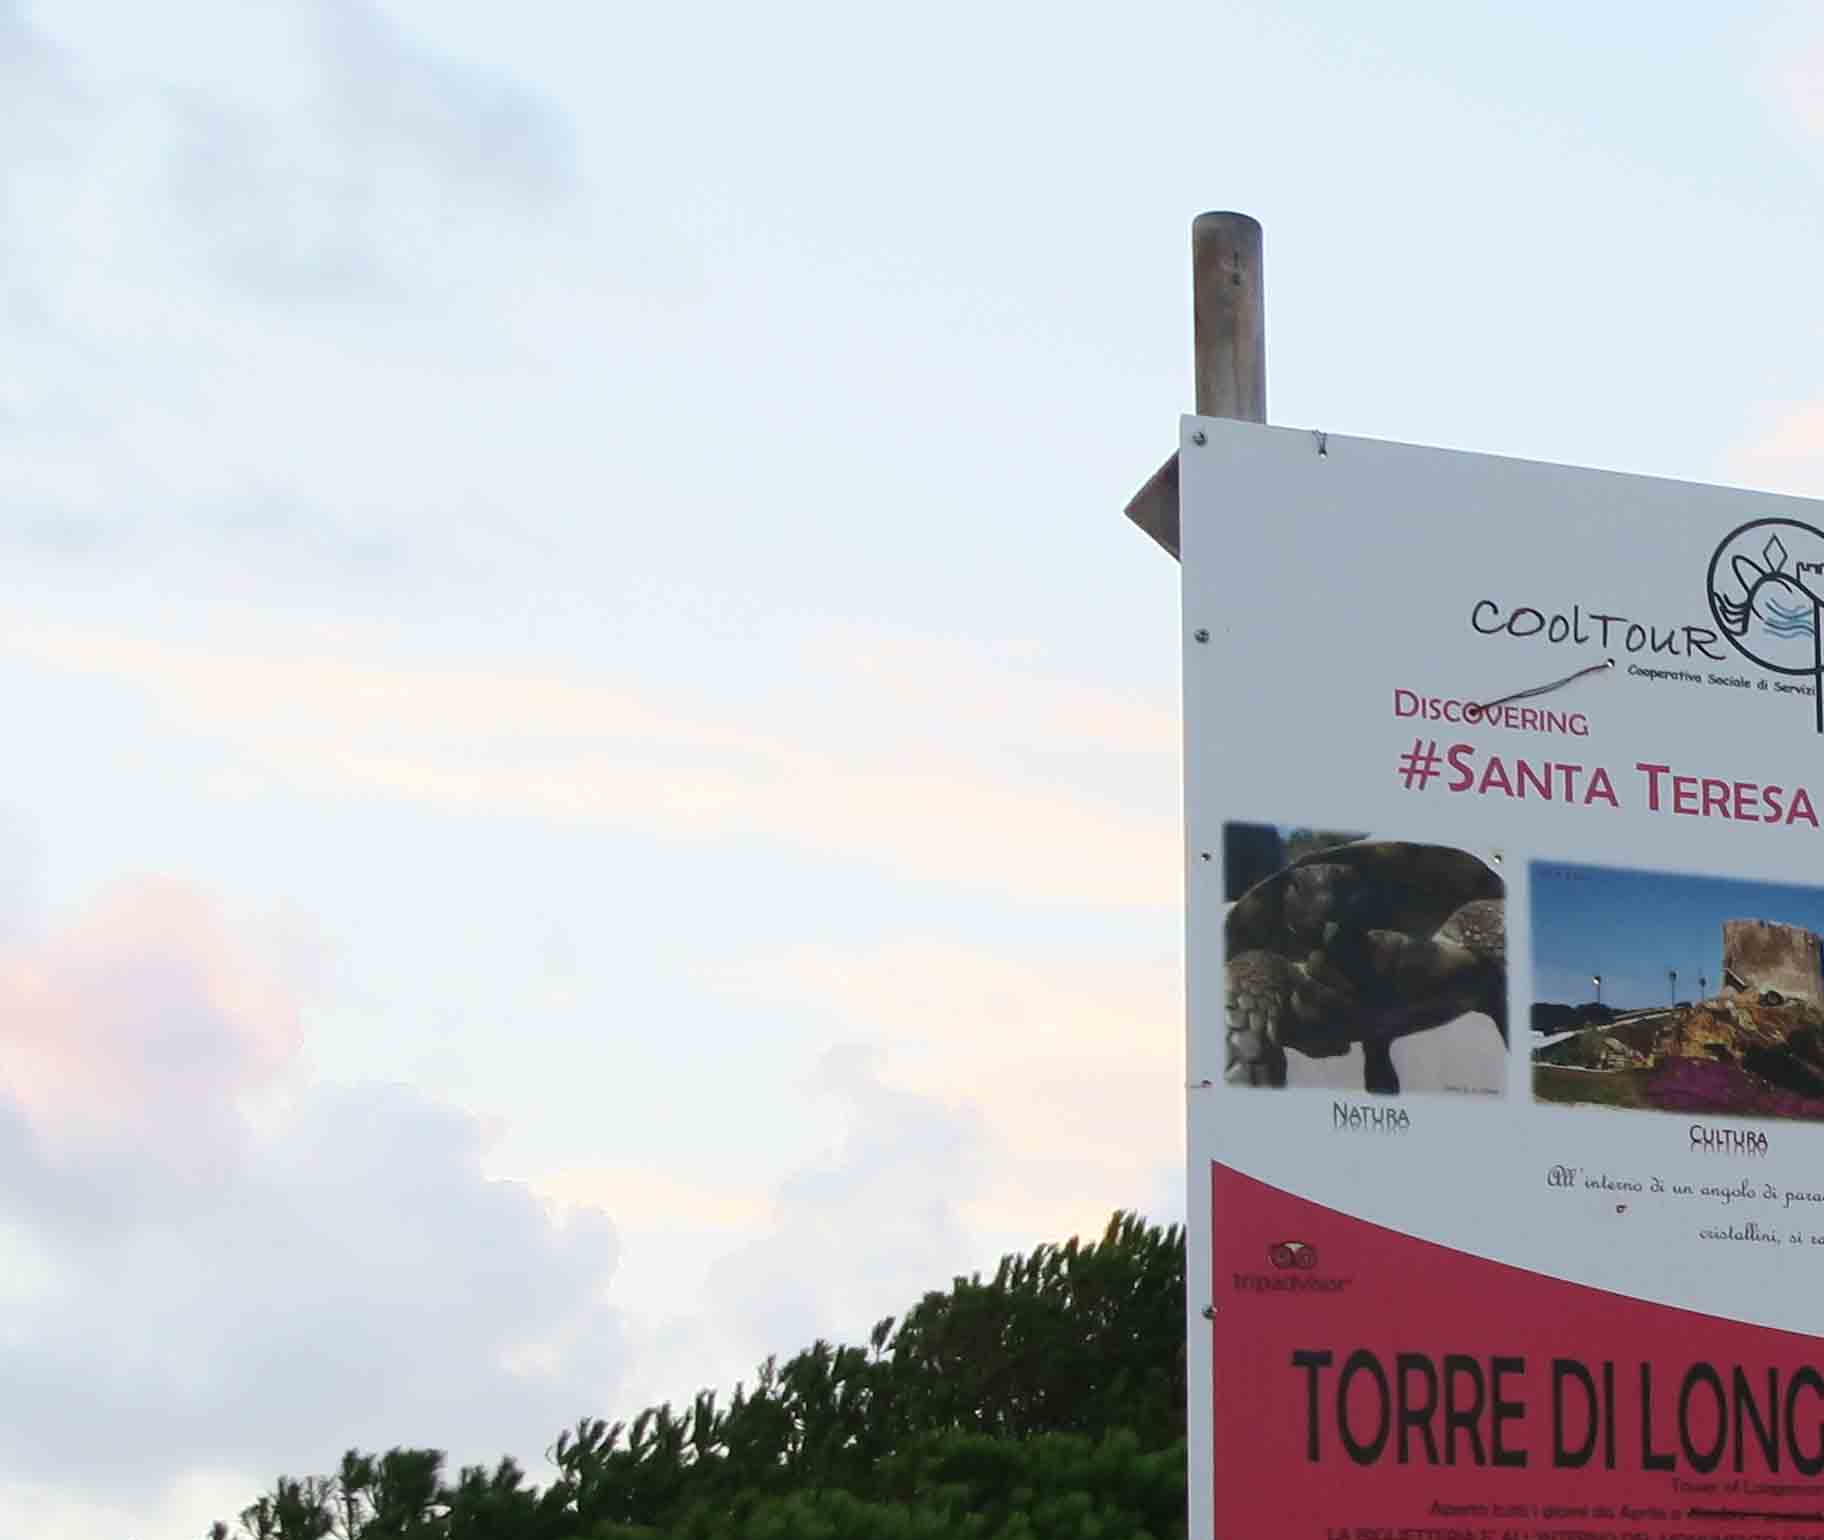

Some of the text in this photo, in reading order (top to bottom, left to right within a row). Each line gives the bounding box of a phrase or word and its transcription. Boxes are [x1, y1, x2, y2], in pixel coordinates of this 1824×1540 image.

[1628, 664, 1702, 685] Cooperativa
[1708, 673, 1752, 690] Sociale
[1757, 679, 1769, 692] di
[1774, 681, 1817, 697] Servizi
[1650, 1177, 1665, 1194] di
[1673, 1184, 1695, 1195] un
[1700, 1179, 1757, 1205] angolo
[1763, 1184, 1778, 1200] di
[1790, 1231, 1802, 1244] si
[1291, 1348, 1528, 1469] TORRE
[1552, 1358, 1617, 1471] DI
